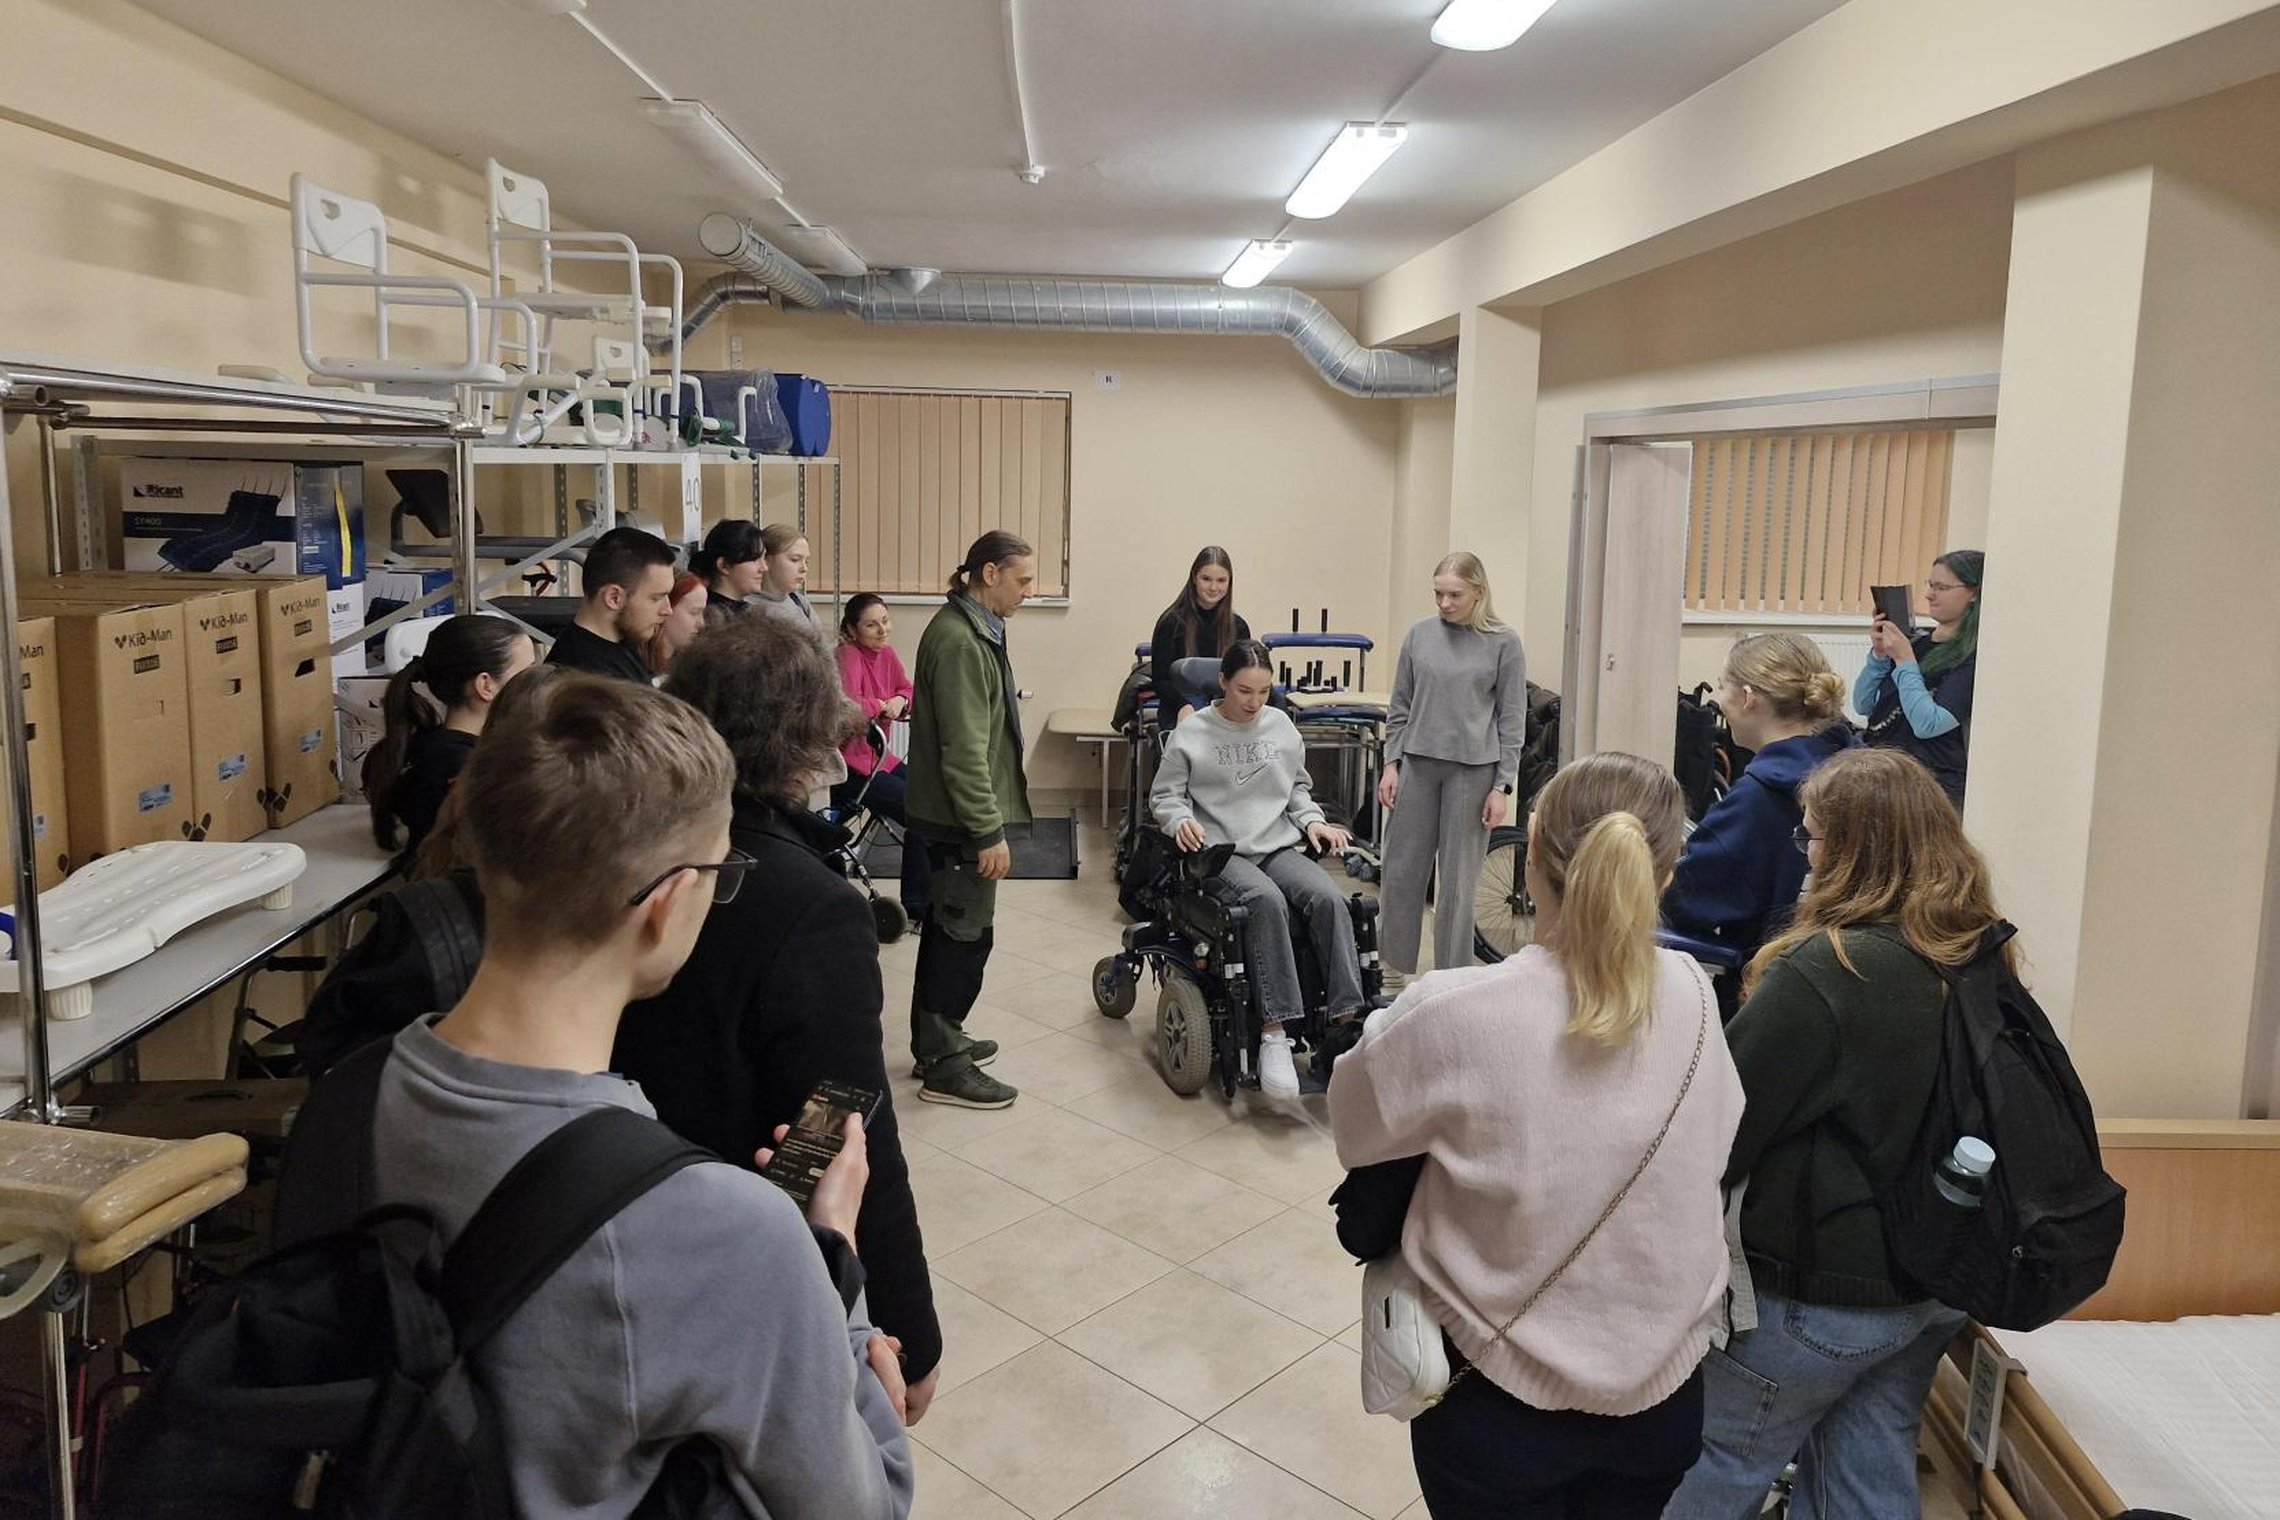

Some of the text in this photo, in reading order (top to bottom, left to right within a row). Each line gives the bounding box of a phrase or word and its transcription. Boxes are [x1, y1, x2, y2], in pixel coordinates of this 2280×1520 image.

[146, 484, 184, 496] Ricant
[290, 597, 321, 615] Kid-Man
[211, 611, 249, 631] Kid-Man
[128, 628, 173, 648] Kid-Man
